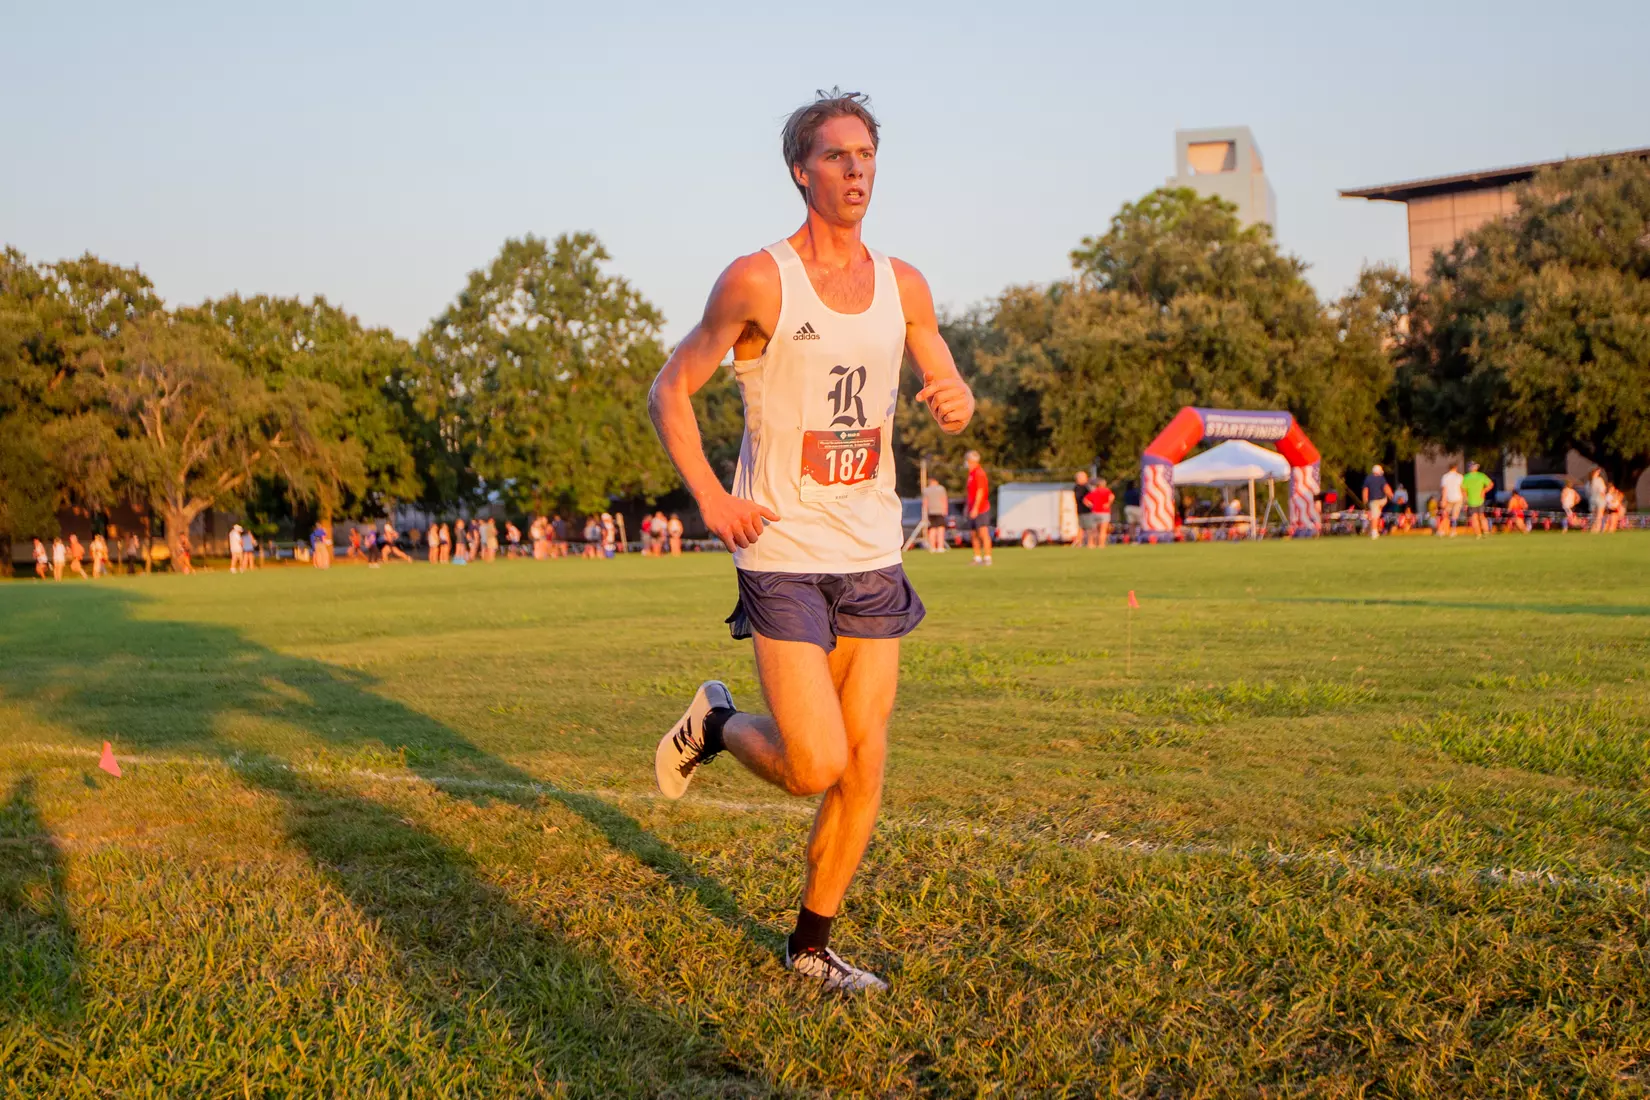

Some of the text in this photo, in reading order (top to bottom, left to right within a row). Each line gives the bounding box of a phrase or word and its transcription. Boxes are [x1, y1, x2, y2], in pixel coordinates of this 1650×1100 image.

[793, 332, 820, 341] adidas
[827, 365, 868, 428] R
[825, 448, 868, 481] 182
